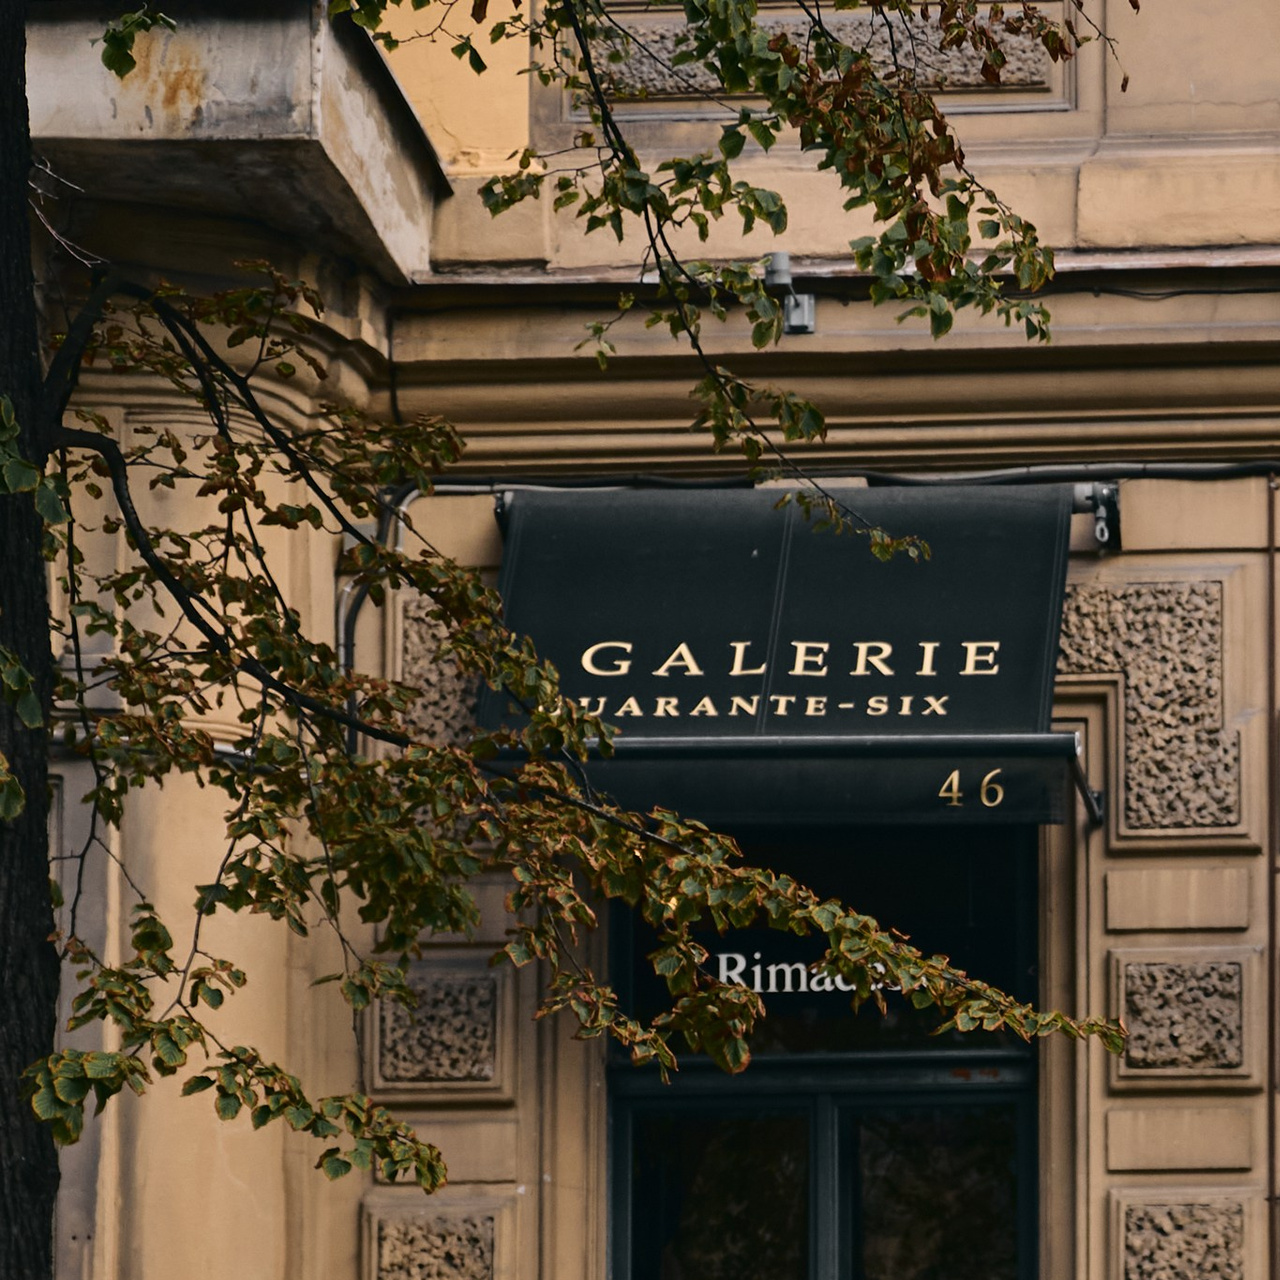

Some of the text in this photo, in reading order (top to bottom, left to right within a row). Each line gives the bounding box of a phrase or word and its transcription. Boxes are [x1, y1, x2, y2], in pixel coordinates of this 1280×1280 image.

[580, 640, 1001, 677] GALERIE
[538, 694, 950, 720] UARANTE-SIX
[937, 768, 1005, 808] 46
